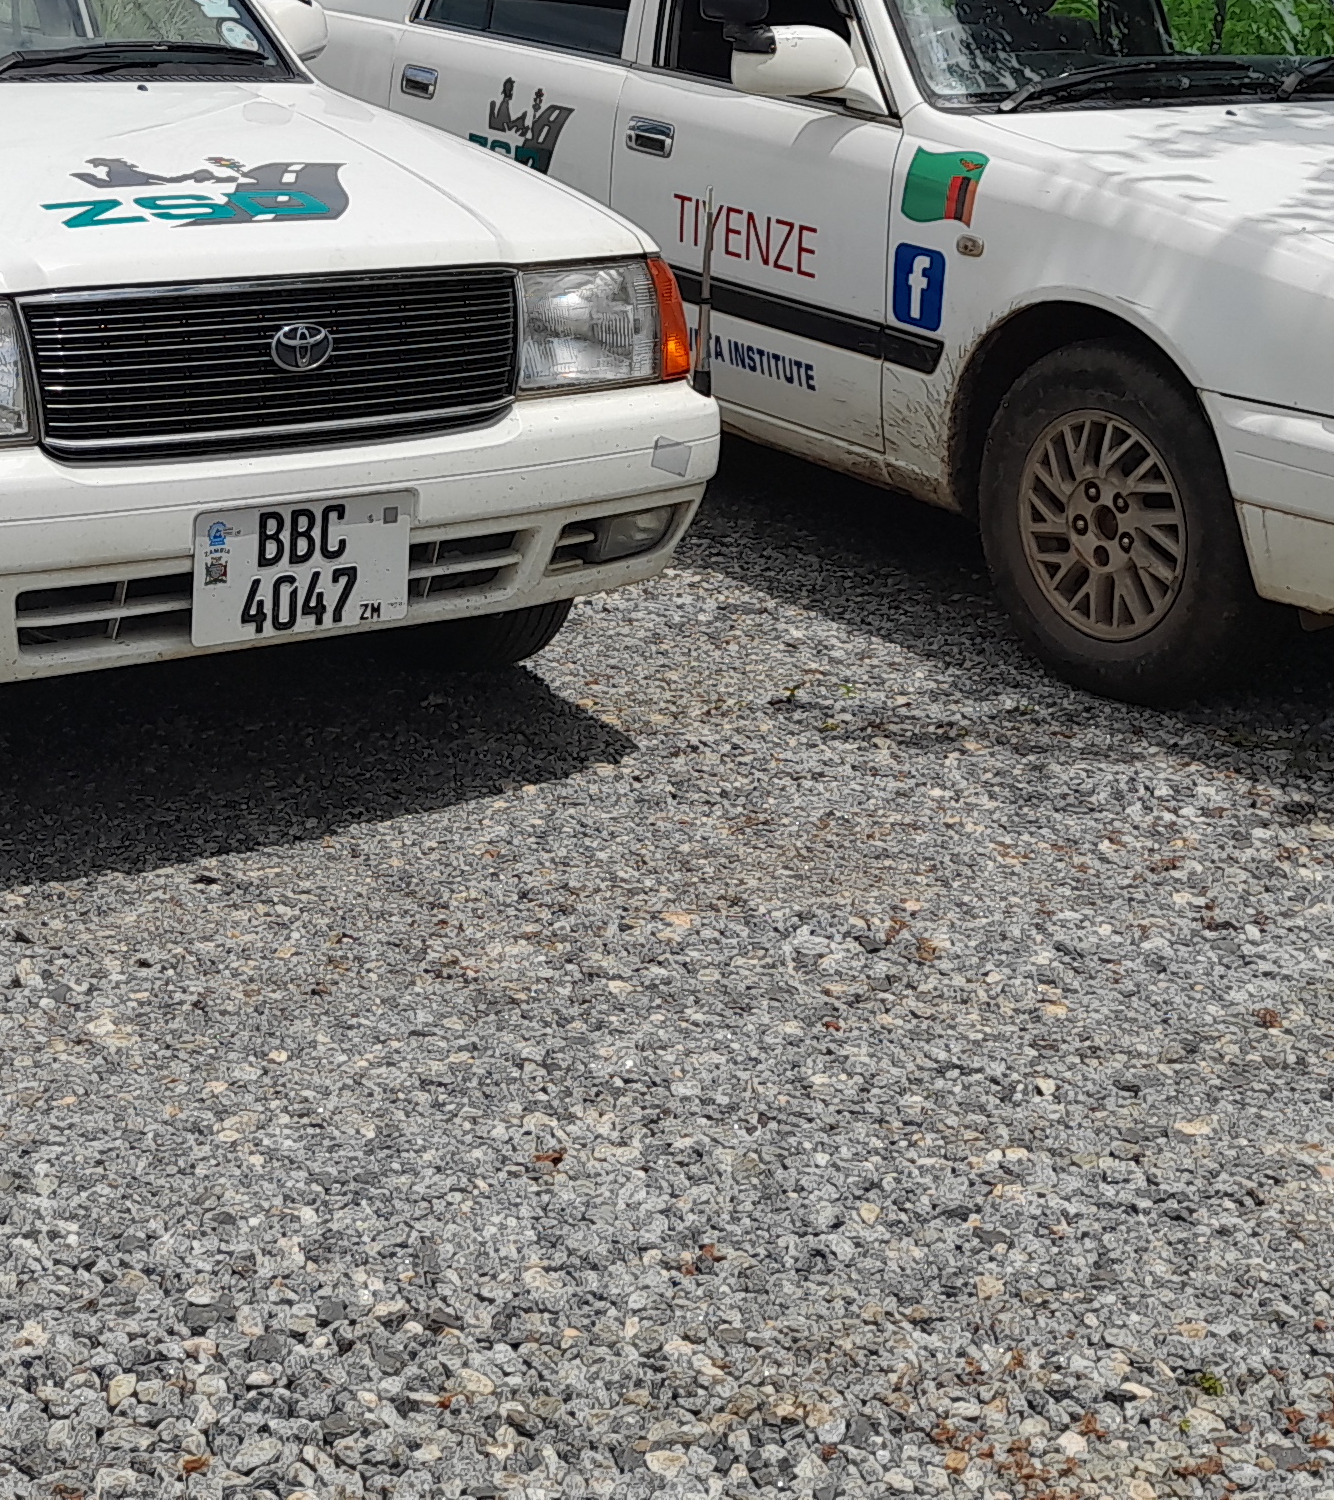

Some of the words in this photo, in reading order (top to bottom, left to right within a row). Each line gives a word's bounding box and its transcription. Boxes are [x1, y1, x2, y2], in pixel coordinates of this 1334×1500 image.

[673, 193, 818, 279] TIYENZE
[728, 338, 816, 391] INSTITUTE
[258, 504, 348, 568] BBC
[240, 565, 358, 633] 4047
[359, 601, 382, 621] ZM
